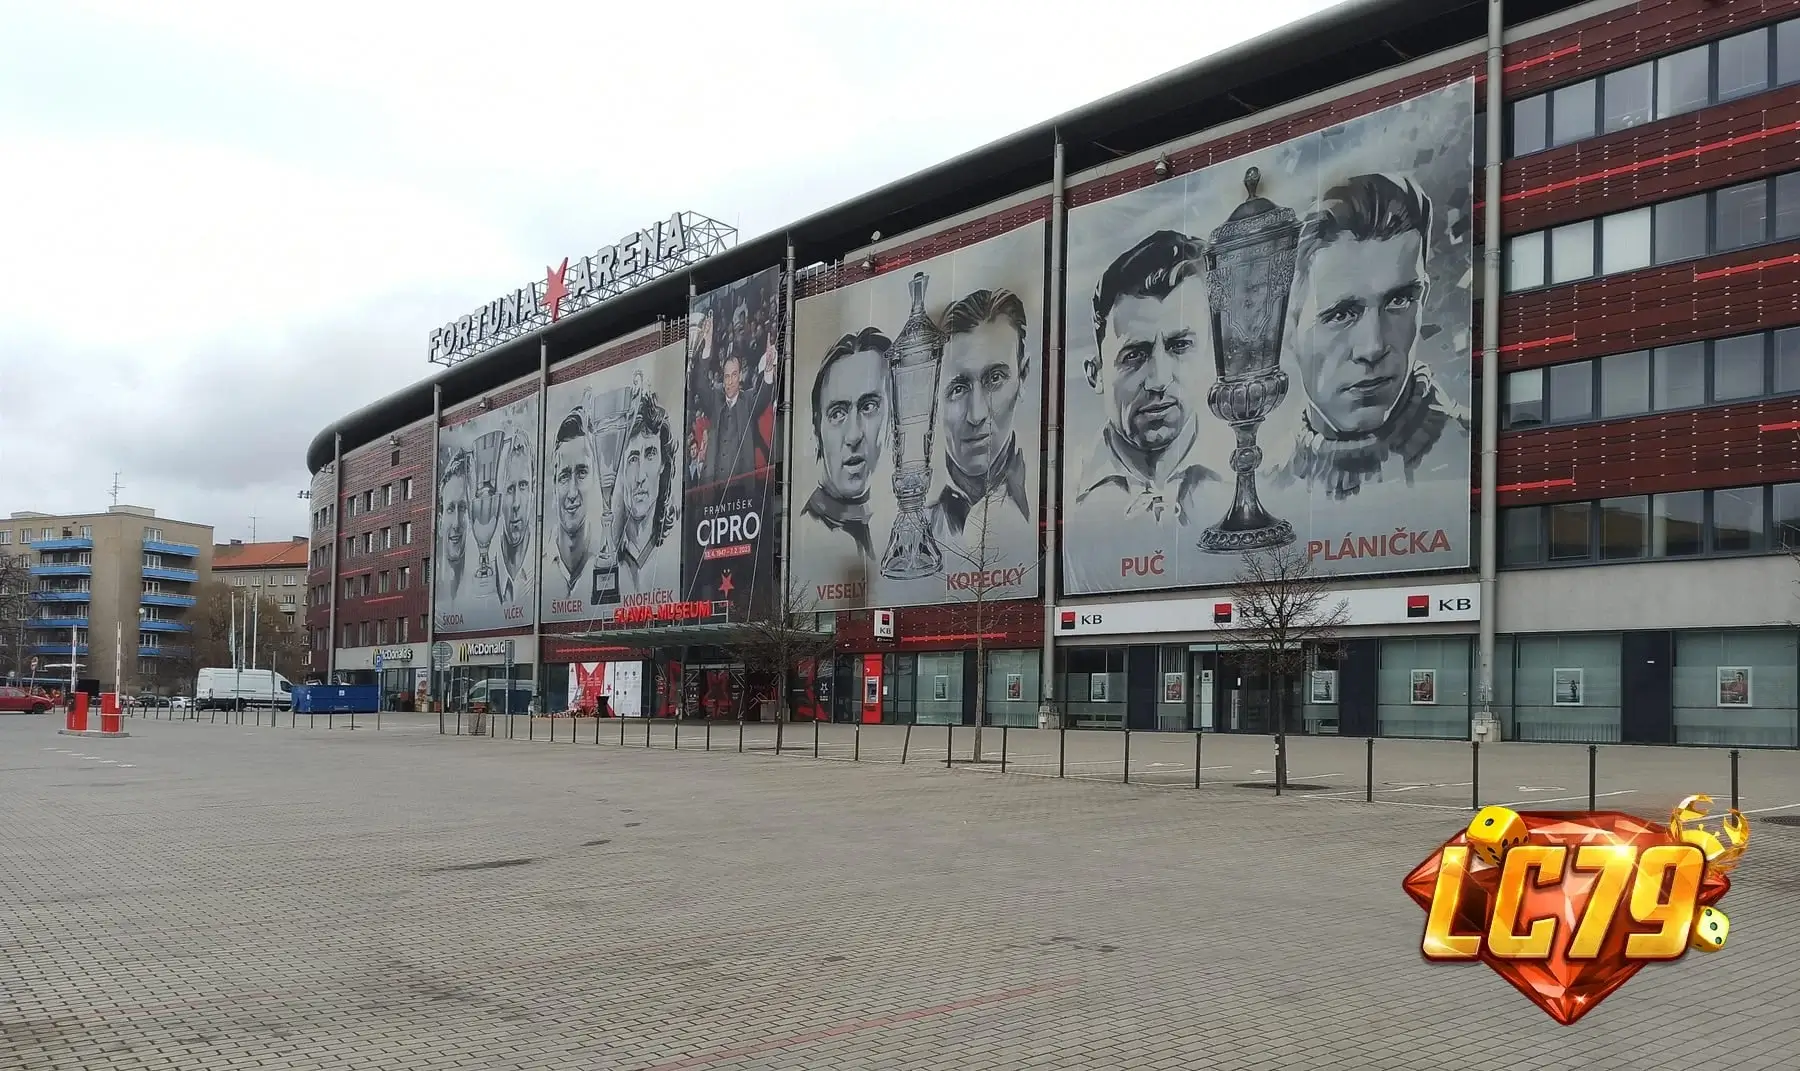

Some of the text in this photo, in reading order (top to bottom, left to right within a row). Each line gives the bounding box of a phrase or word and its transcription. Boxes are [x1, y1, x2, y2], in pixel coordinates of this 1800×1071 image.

[428, 211, 687, 362] FORTUNA ARENA
[704, 498, 753, 516] FRANTIŠEK
[696, 511, 760, 547] CIPRO
[1307, 527, 1452, 561] PLÁNIČKA
[1121, 550, 1165, 576] PUČ
[947, 563, 1025, 590] KOPECKÝ
[623, 588, 674, 607] KNOFLÍČEK
[1439, 598, 1472, 611] KB
[503, 605, 524, 620] VLČEK
[551, 600, 583, 614] ŠMICER
[442, 612, 464, 626] ŠKODA
[1081, 614, 1103, 625] KB
[880, 627, 892, 635] KB
[468, 641, 506, 656] McDonald
